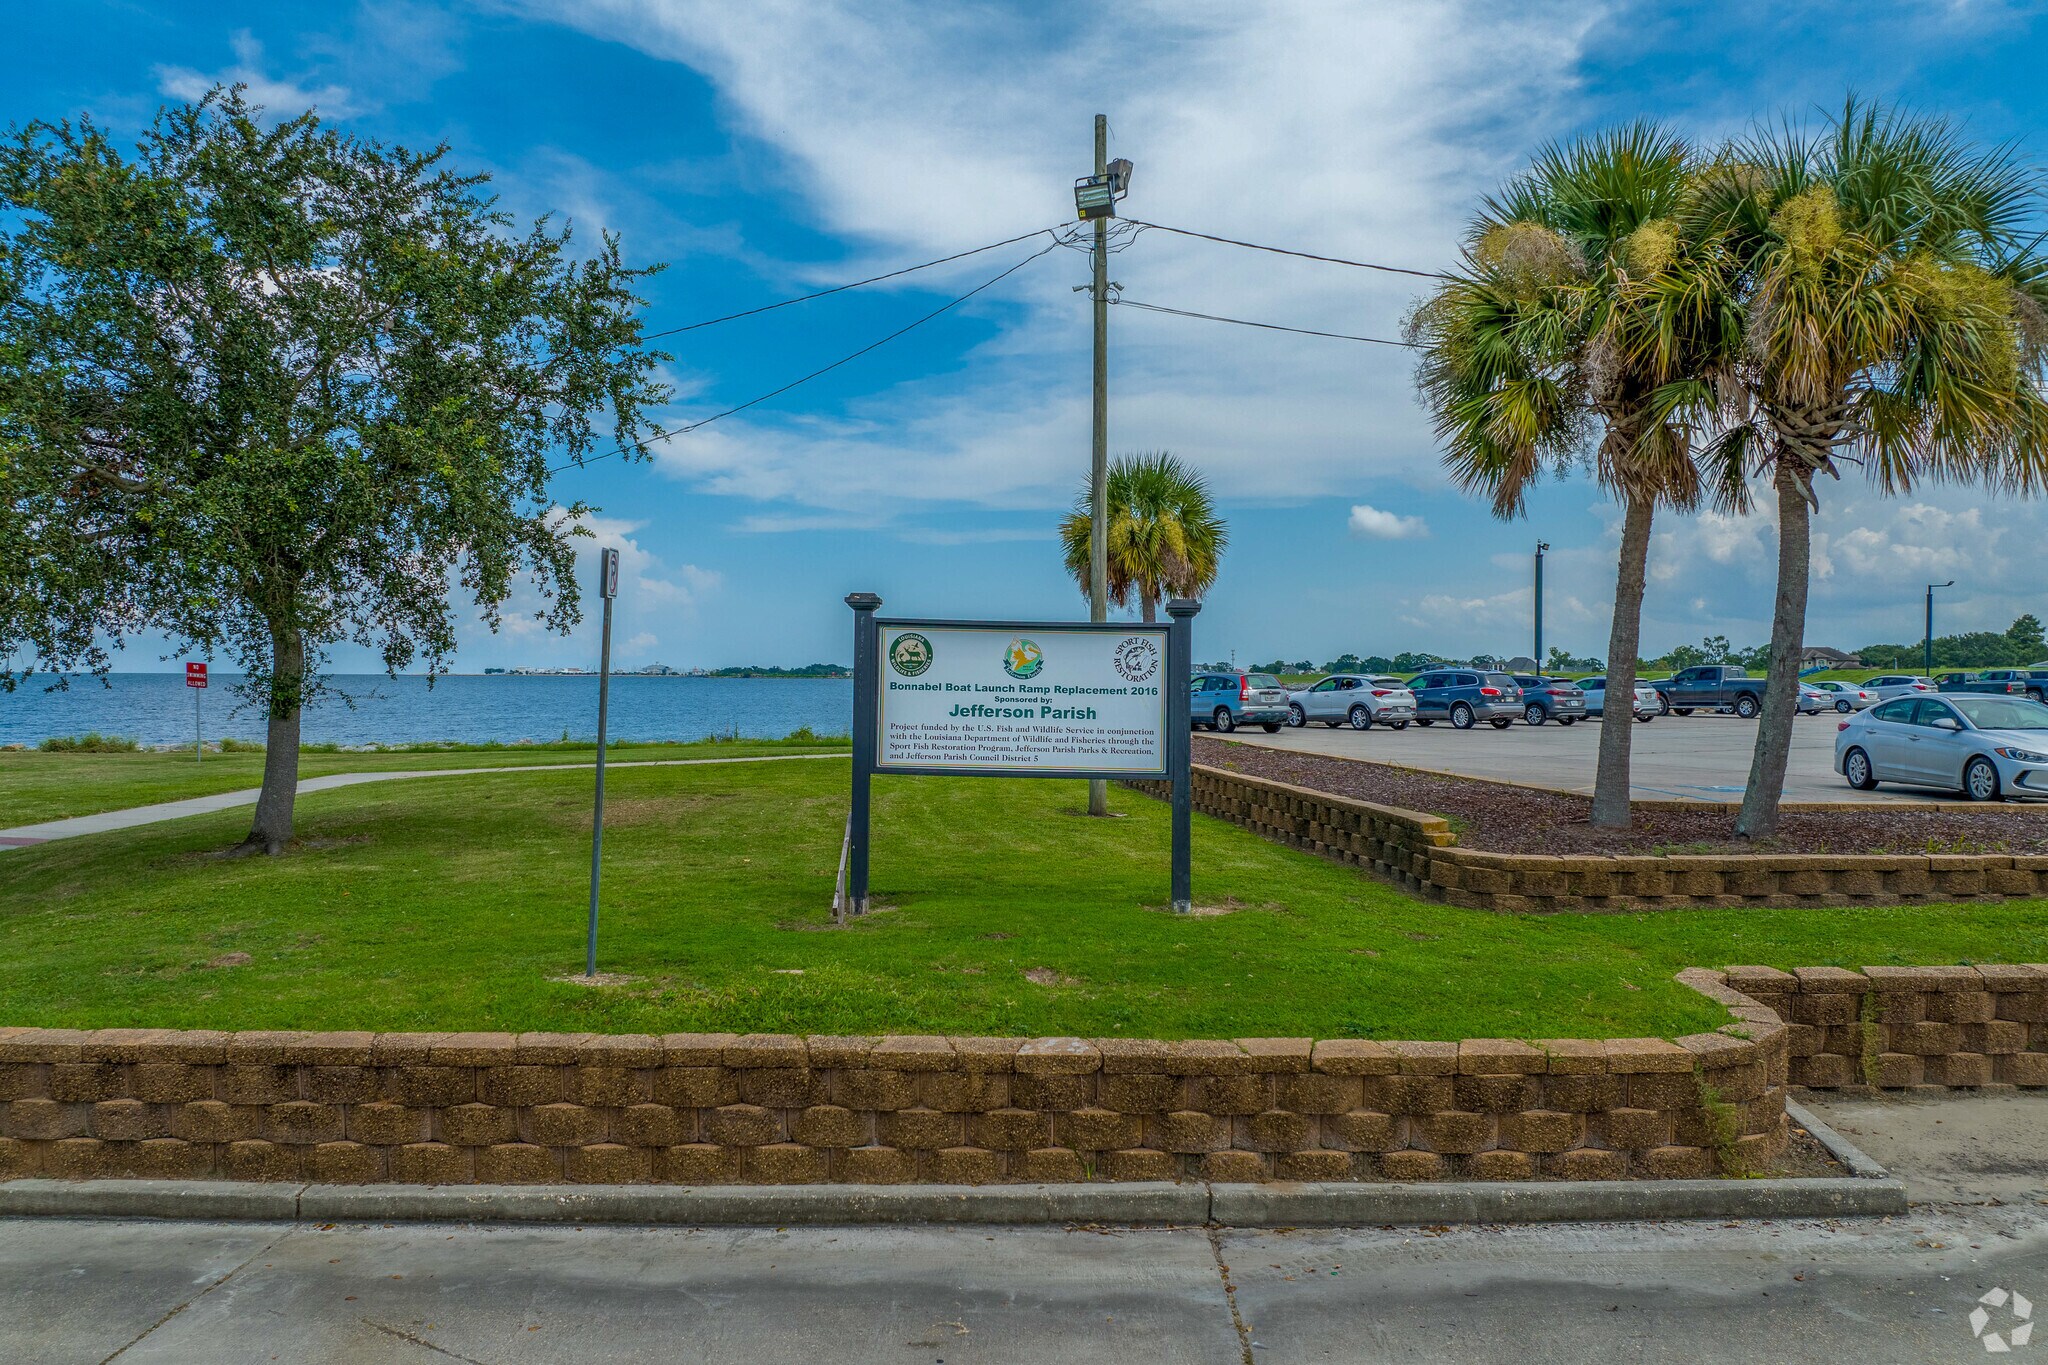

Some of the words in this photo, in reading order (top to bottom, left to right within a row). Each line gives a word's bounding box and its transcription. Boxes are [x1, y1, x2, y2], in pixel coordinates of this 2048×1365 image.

[898, 634, 925, 643] LOUISIANA
[1115, 637, 1139, 655] SPORT
[1140, 638, 1157, 656] FISH
[890, 659, 907, 675] WILDLIFE
[912, 659, 931, 675] FISHERIES
[1114, 658, 1158, 682] RESTORATION
[890, 682, 941, 691] Bonnabel
[945, 683, 971, 692] Boat
[975, 684, 1015, 692] Launch
[1019, 684, 1050, 695] Ramp
[1054, 685, 1127, 695] Replacement
[1131, 687, 1158, 695] 2016
[994, 695, 1038, 703] Sponsored
[949, 704, 1034, 718] Jefferson
[1040, 706, 1096, 719] Parish
[890, 723, 918, 731] Project
[921, 723, 948, 731] funded
[950, 724, 959, 732] by
[1107, 727, 1154, 736] conjunction
[924, 733, 962, 741] Louisiana
[964, 734, 1010, 742] Department
[1022, 735, 1053, 743] Wildlife
[1071, 736, 1106, 744] Fisheries
[1108, 737, 1139, 745] through
[889, 742, 911, 751] Sport
[931, 743, 976, 751] Restoration
[978, 744, 1013, 752] Program,
[906, 752, 941, 760] Jefferson
[943, 753, 968, 761] Parish
[1002, 754, 1031, 762] District
